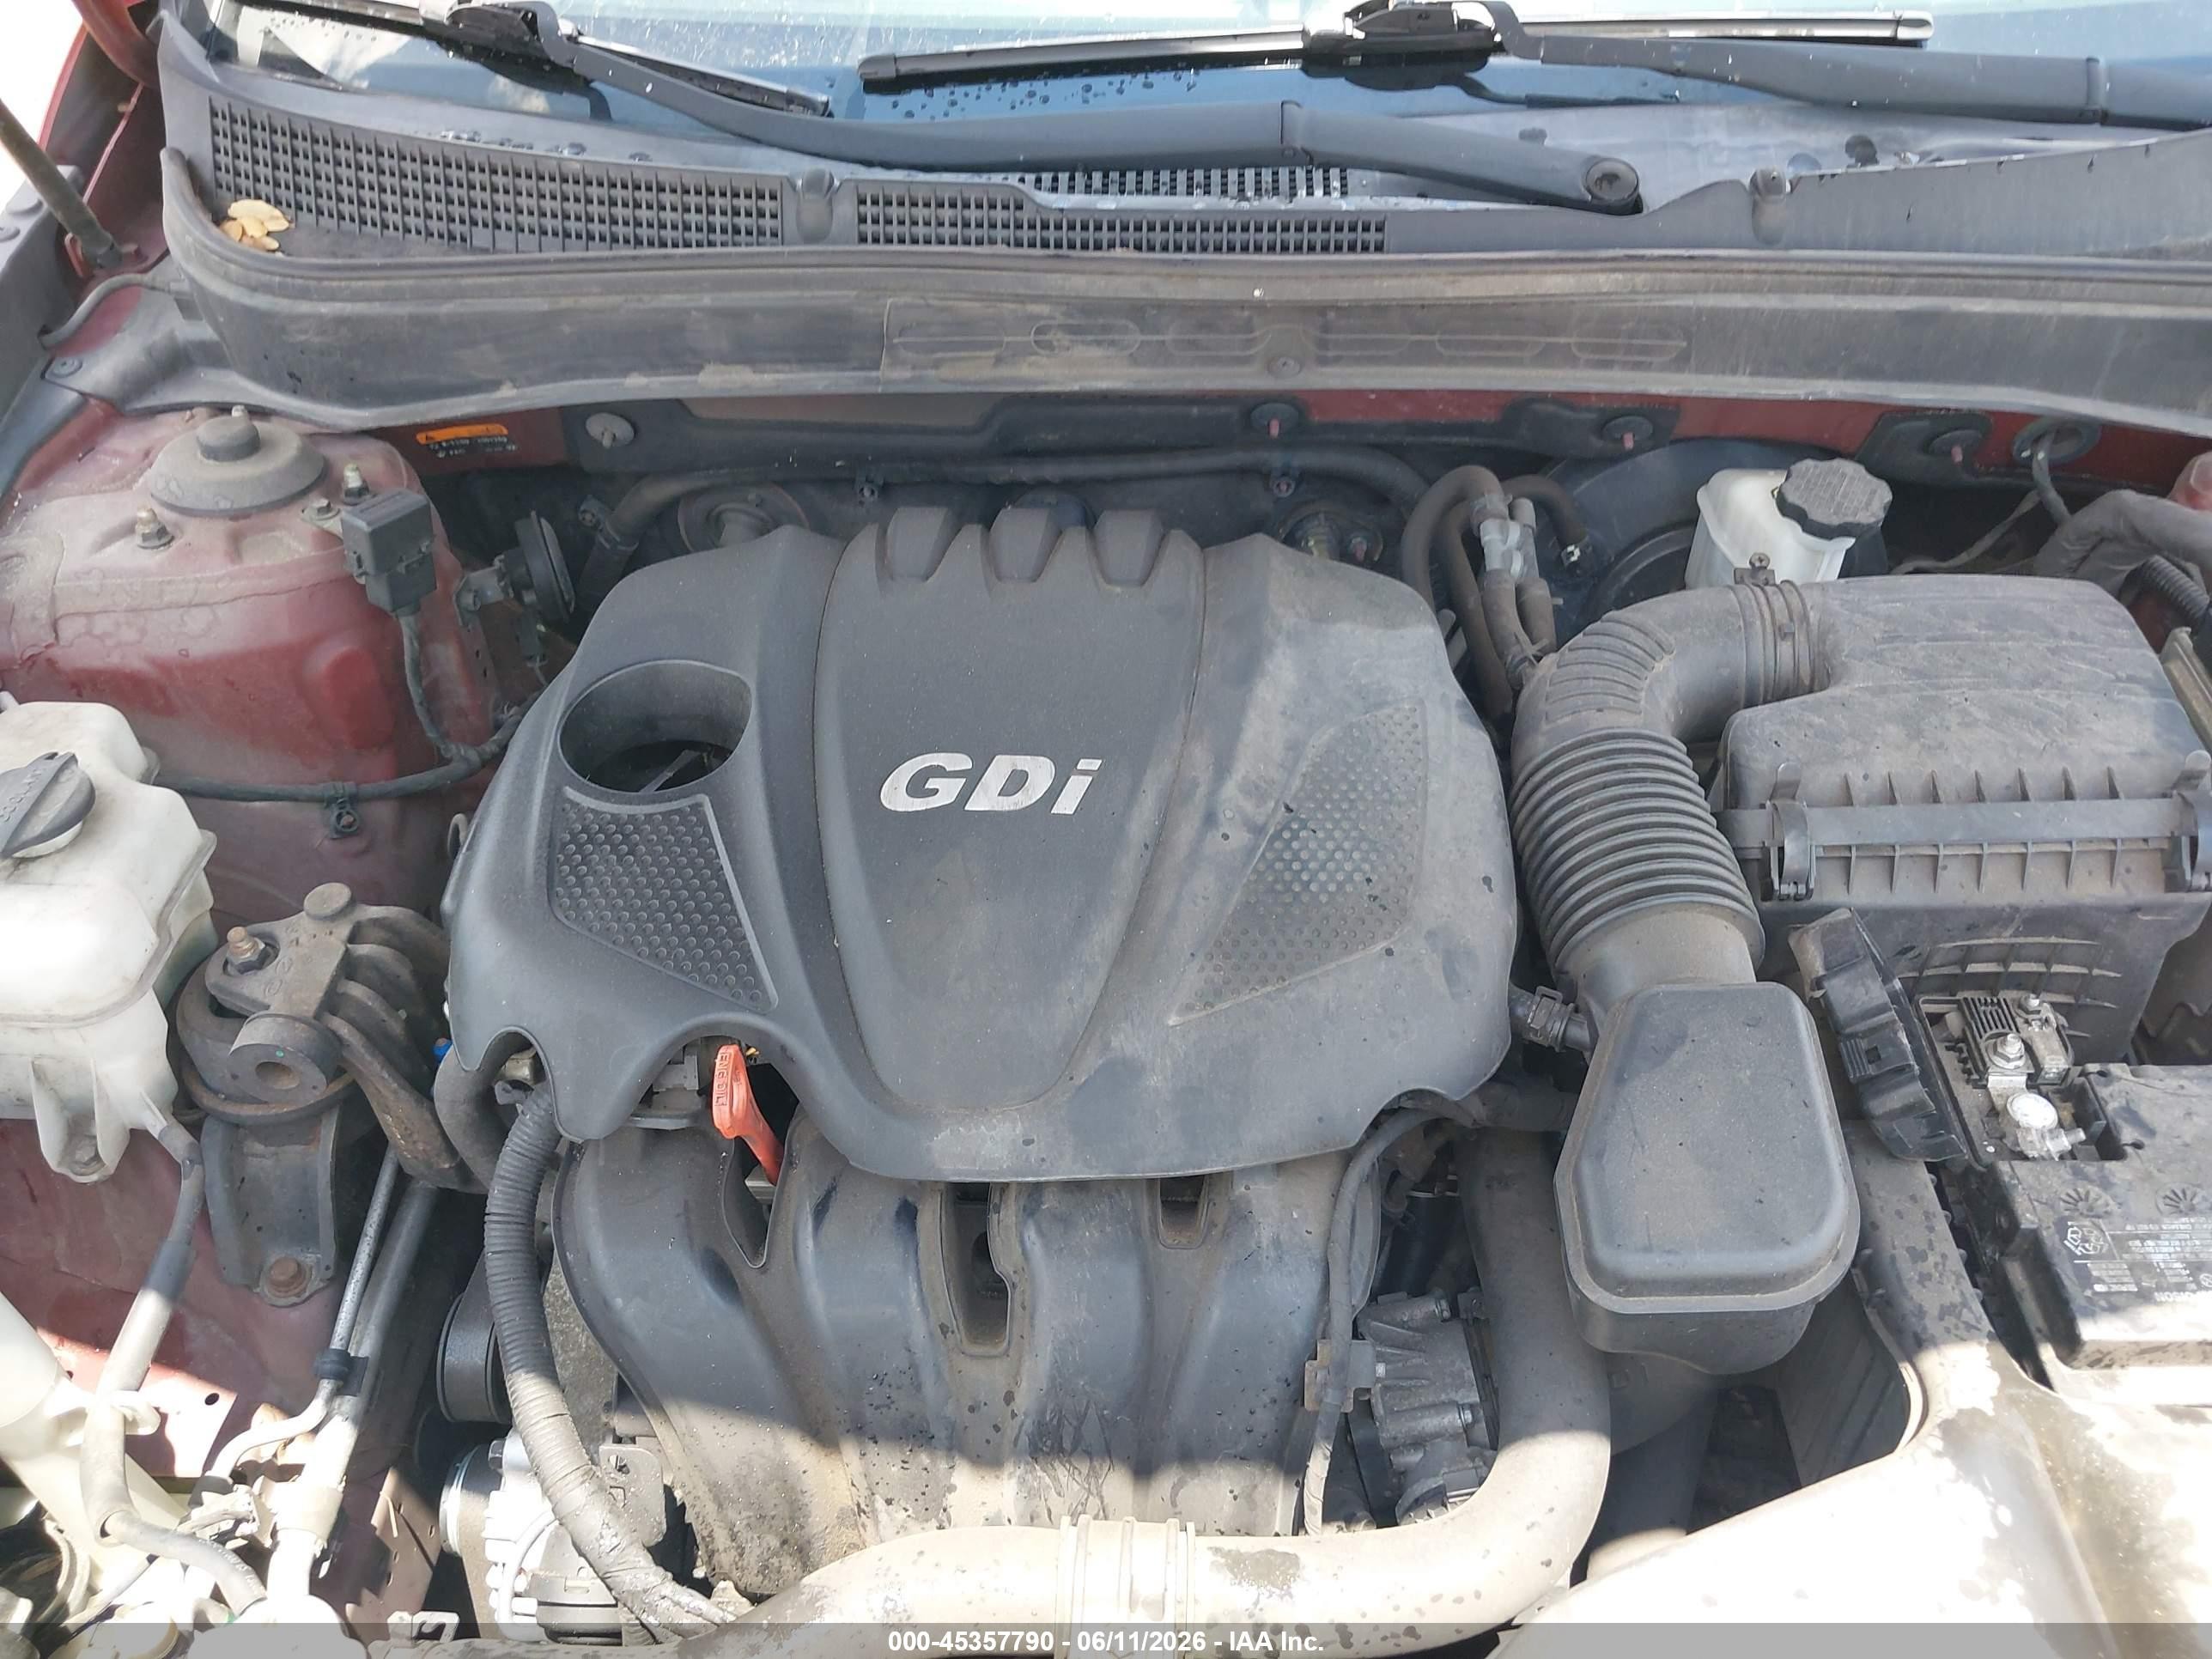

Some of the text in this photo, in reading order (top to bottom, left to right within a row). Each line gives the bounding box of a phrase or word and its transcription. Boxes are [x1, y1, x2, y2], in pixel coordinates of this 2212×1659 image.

[880, 752, 1102, 815] GDi
[715, 1053, 730, 1104] ENG OIL
